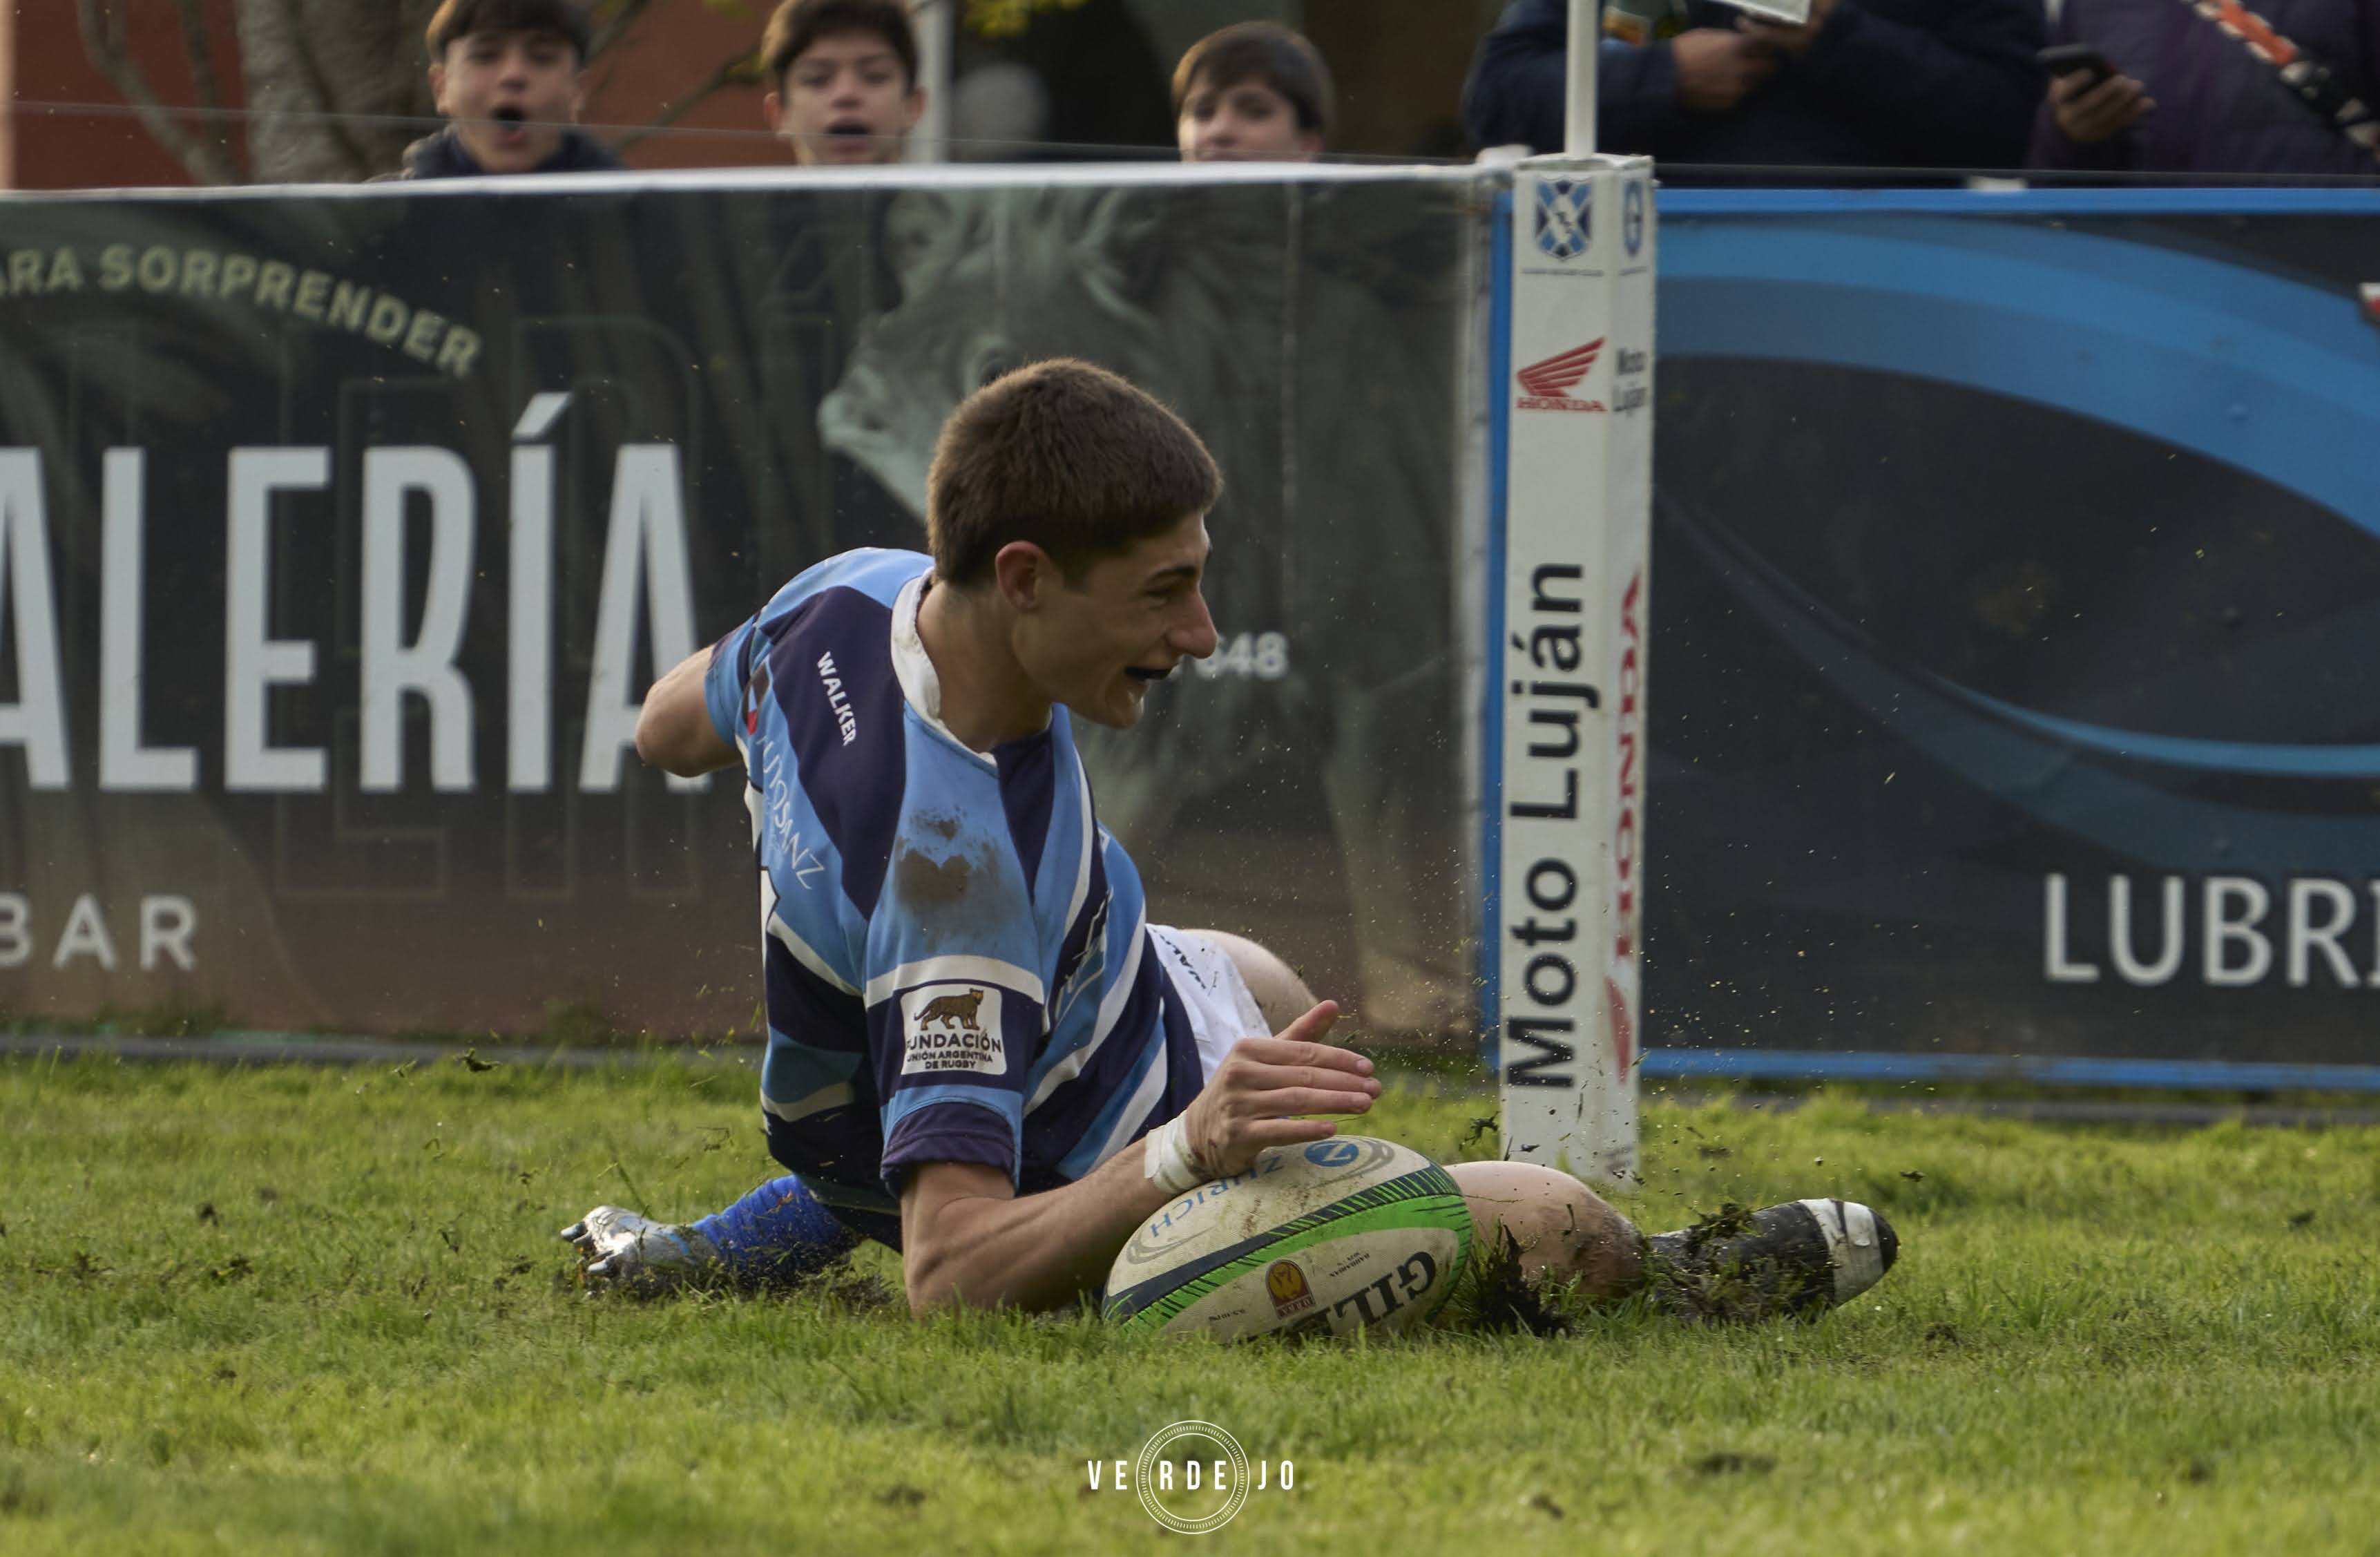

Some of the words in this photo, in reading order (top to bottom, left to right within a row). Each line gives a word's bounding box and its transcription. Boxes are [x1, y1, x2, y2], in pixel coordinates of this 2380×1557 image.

[0, 247, 84, 297] RA
[97, 244, 483, 377] SORPRENDER
[1517, 397, 1608, 413] HONDA
[817, 650, 857, 747] WALKER
[1508, 563, 1601, 820] Luján
[1506, 857, 1580, 1090] Moto
[925, 1061, 939, 1069] DE
[941, 1059, 977, 1069] RUGBY
[938, 1050, 993, 1063] ARGENTINA
